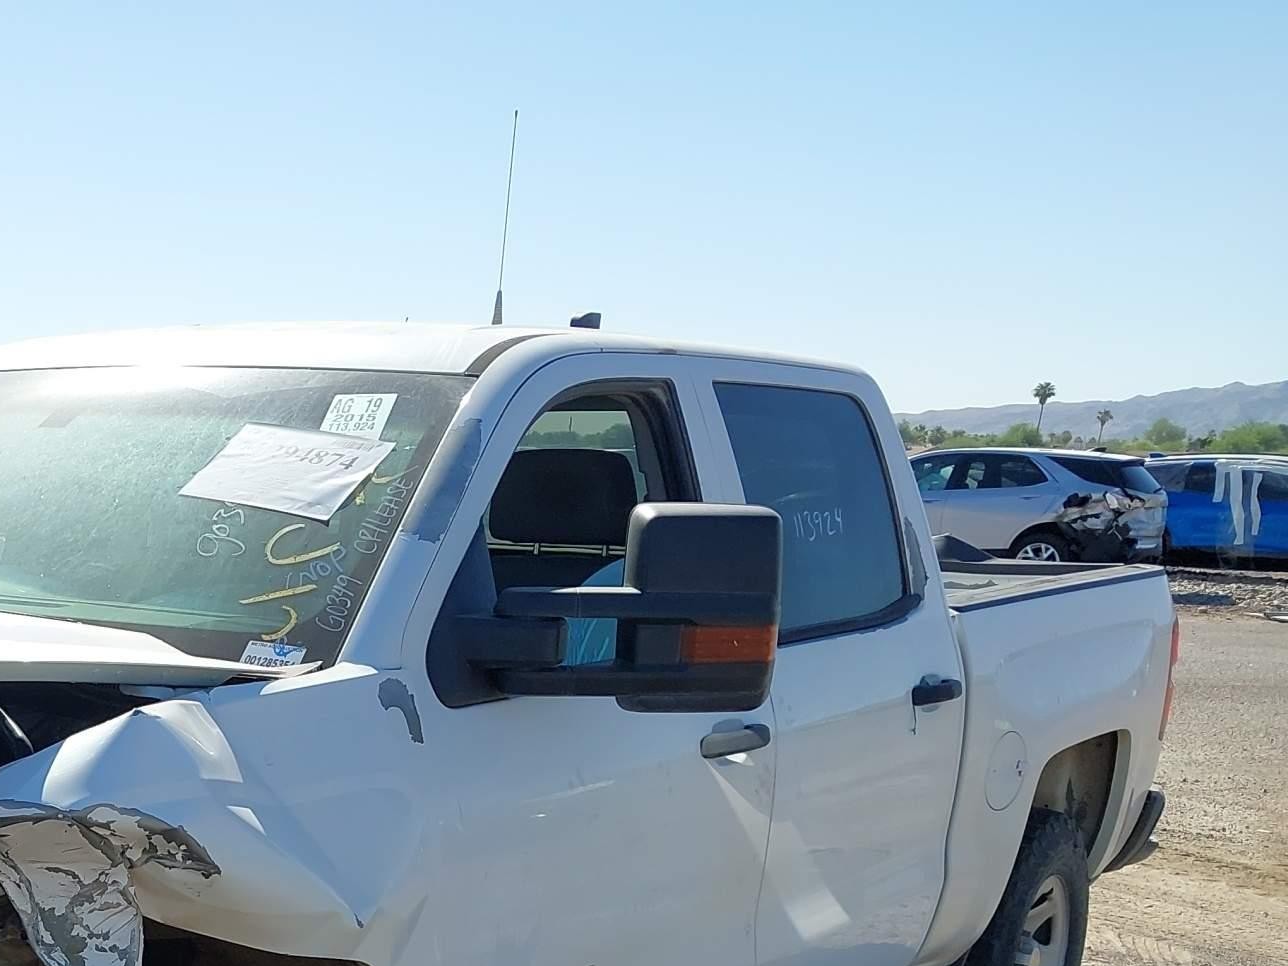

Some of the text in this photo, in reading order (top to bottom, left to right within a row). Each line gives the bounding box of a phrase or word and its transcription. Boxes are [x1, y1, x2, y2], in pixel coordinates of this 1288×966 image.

[330, 397, 383, 414] AG 19
[332, 413, 377, 423] 2015
[793, 507, 843, 542] 113924
